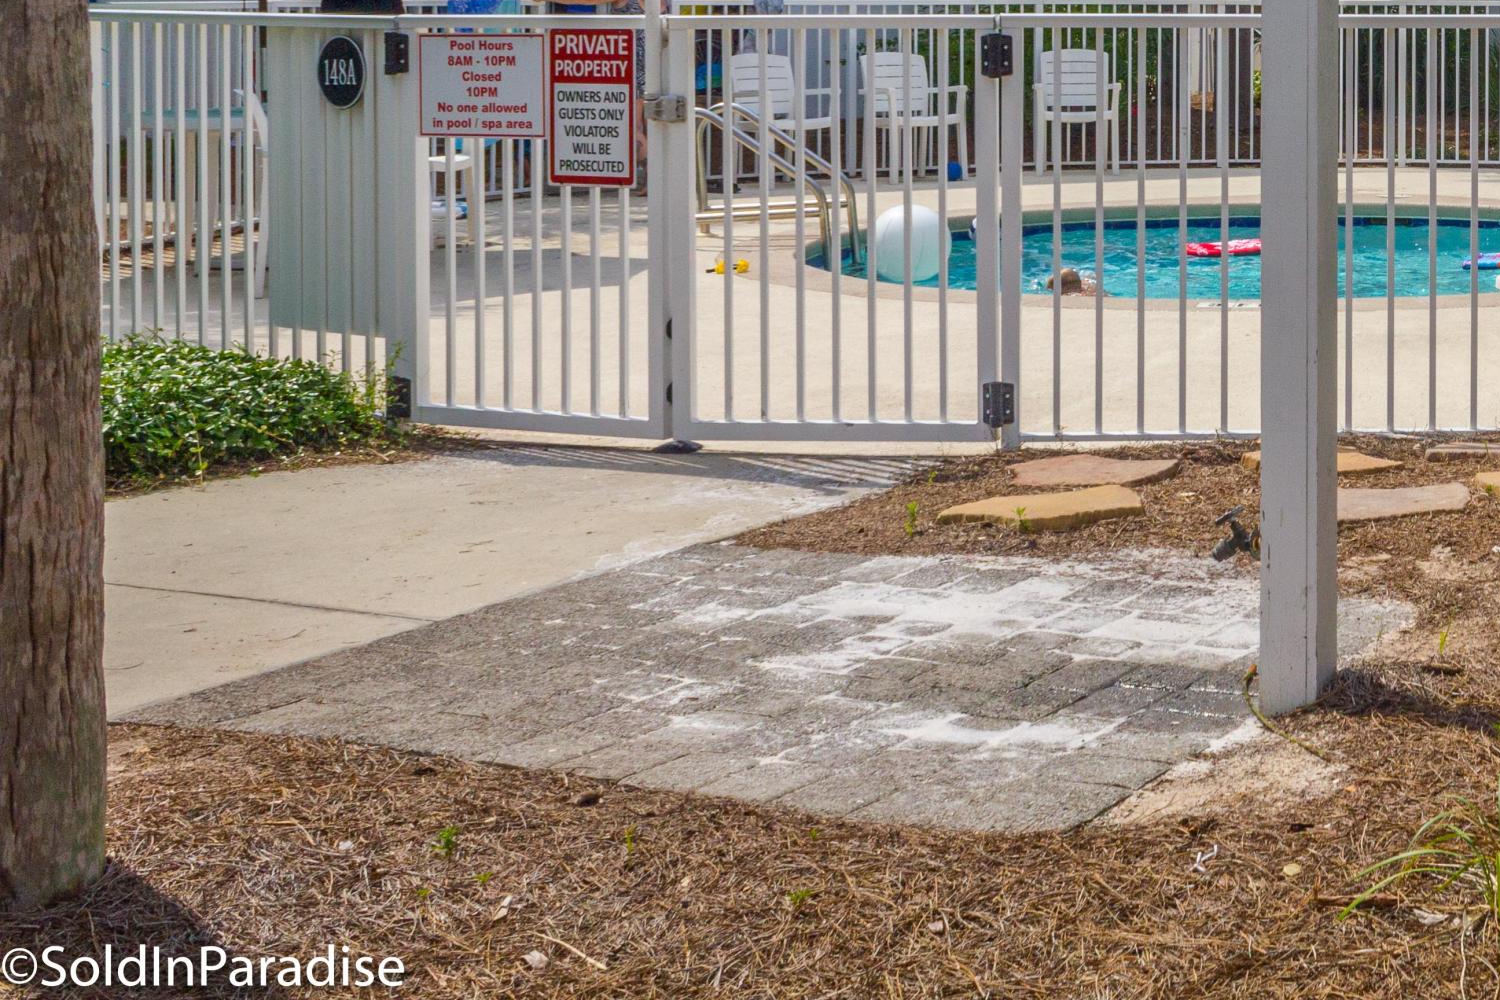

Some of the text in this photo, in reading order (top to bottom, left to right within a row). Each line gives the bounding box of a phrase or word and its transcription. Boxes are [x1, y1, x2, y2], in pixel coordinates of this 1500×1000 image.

[450, 40, 514, 51] Pool Hours
[554, 34, 629, 55] PRIVATE
[447, 56, 473, 66] 8AM
[484, 56, 516, 66] 10PM
[324, 59, 357, 85] 148A
[555, 60, 628, 77] PROPERTY
[462, 71, 502, 82] Closed
[466, 87, 498, 97] 10PM
[557, 90, 626, 103] OWNERS AND
[437, 102, 527, 113] No one allowed
[559, 107, 625, 120] GUESTS ONLY
[432, 117, 443, 128] in
[447, 117, 472, 130] pool
[481, 120, 502, 130] spa
[506, 120, 533, 129] area
[564, 125, 619, 138] VIOLATORS
[572, 142, 612, 155] WILL BE
[559, 160, 625, 172] PROSECUTED
